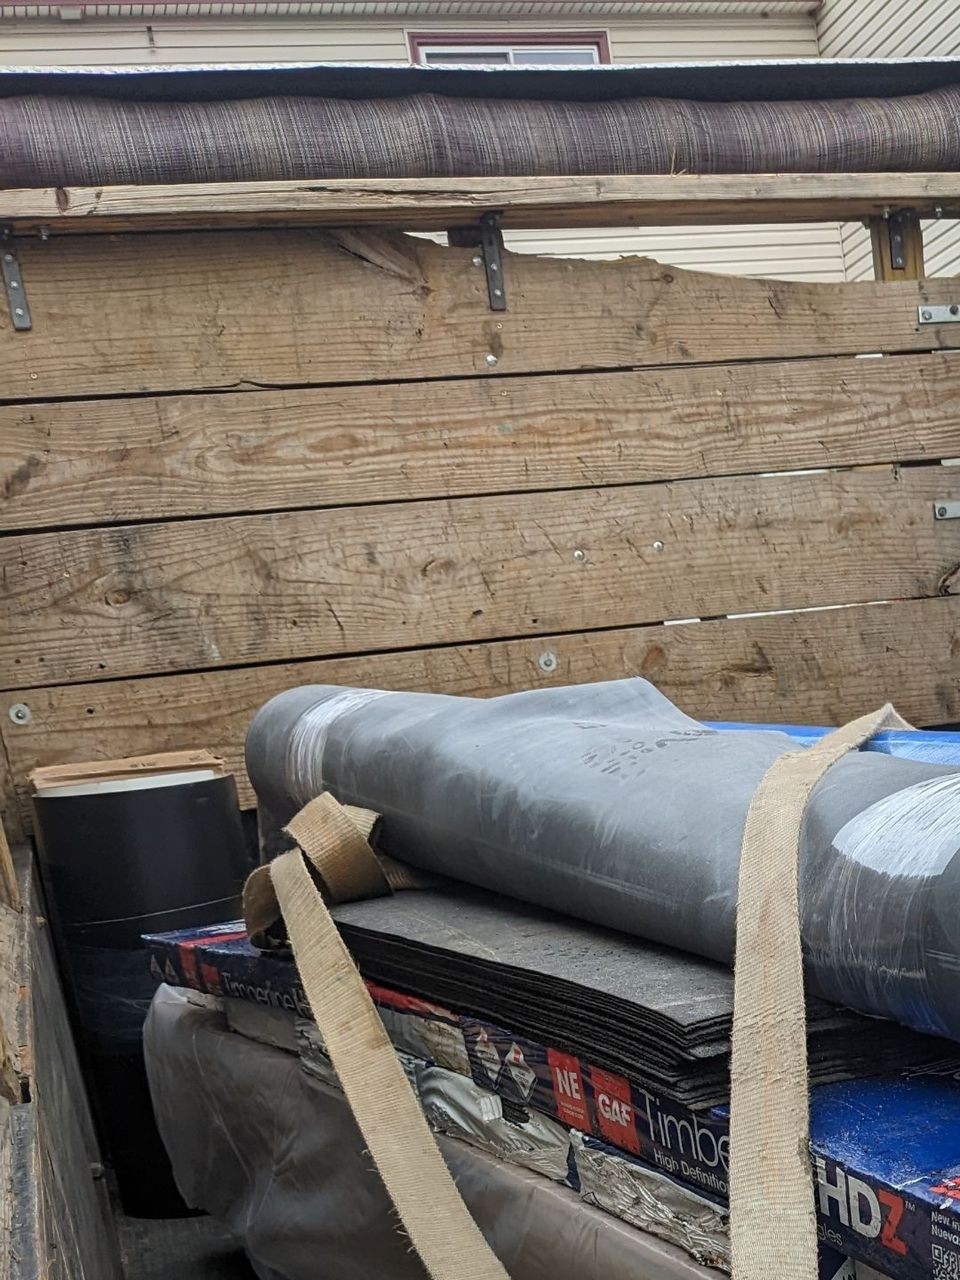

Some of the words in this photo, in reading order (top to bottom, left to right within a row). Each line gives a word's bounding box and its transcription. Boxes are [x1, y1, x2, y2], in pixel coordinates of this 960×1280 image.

[555, 1066, 582, 1100] NE
[598, 1093, 632, 1127] GAF
[639, 1087, 730, 1173] Timbe
[653, 1148, 680, 1172] High
[680, 1160, 730, 1194] Definitio
[816, 1222, 843, 1247] gles
[931, 1211, 951, 1227] New
